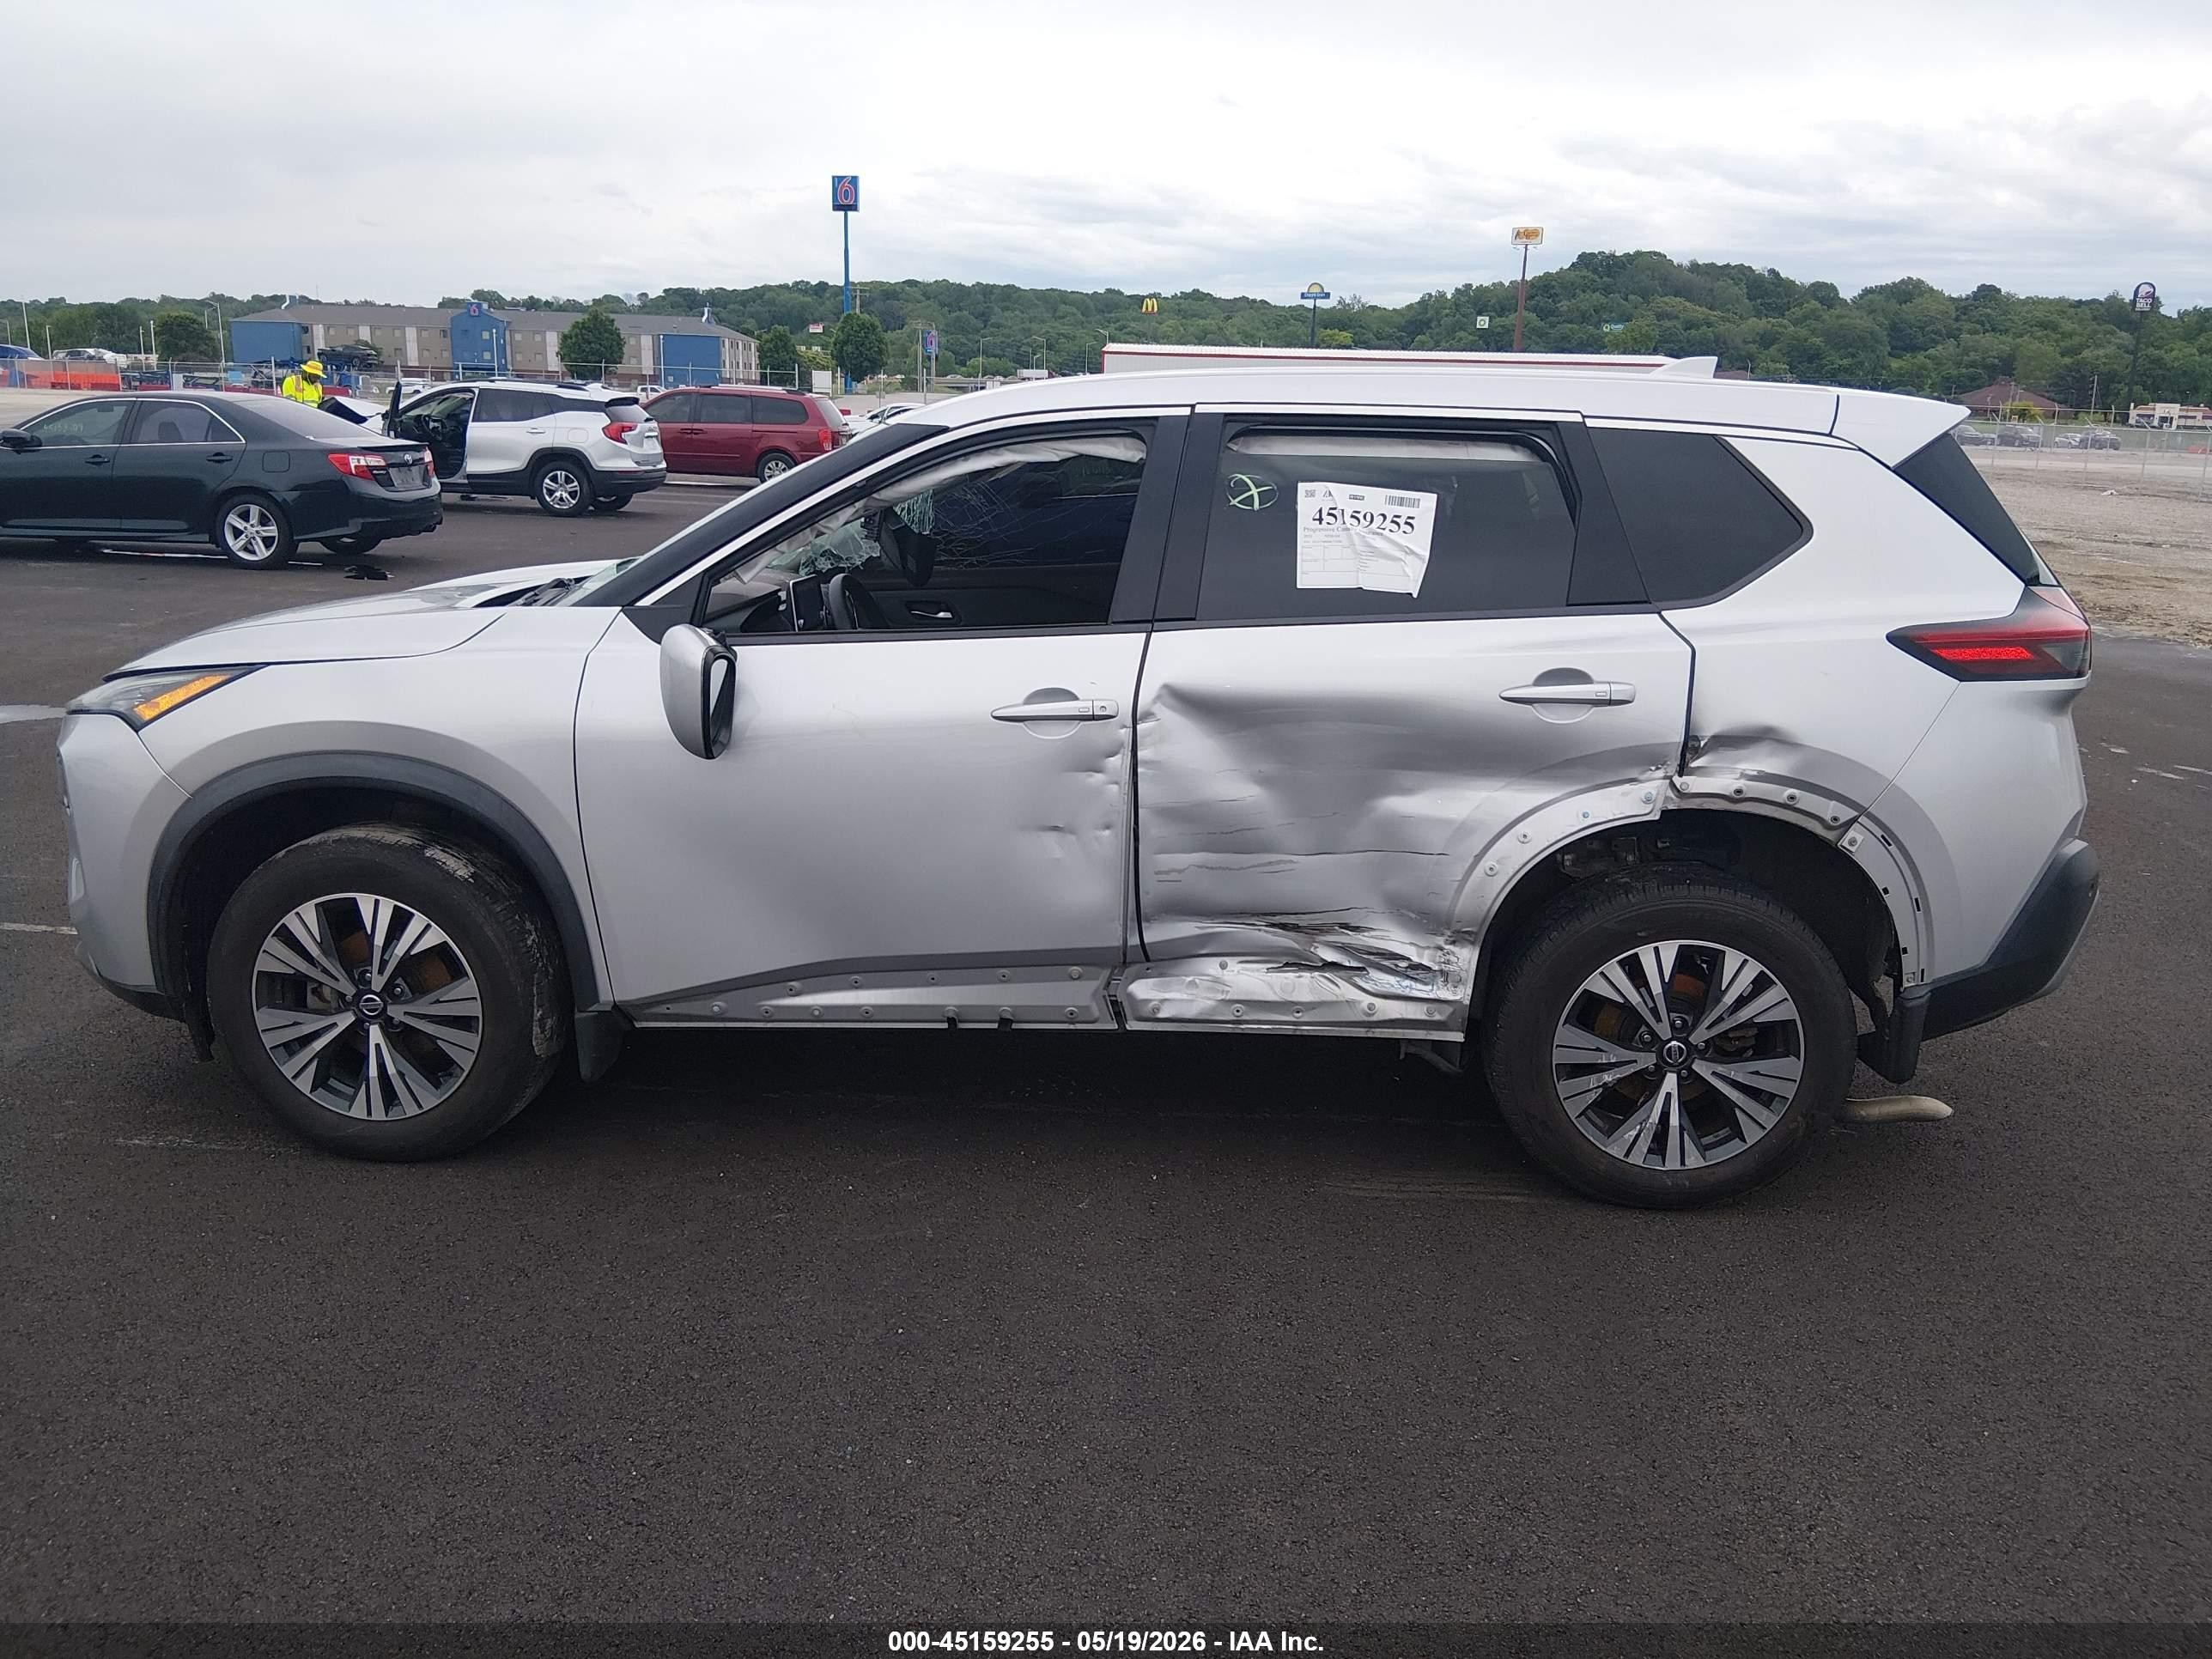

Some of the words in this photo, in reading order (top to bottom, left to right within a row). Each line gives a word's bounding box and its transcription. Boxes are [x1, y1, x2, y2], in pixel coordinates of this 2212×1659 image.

[837, 176, 855, 205] 6
[470, 304, 479, 317] 6
[1312, 507, 1416, 534] 45159255
